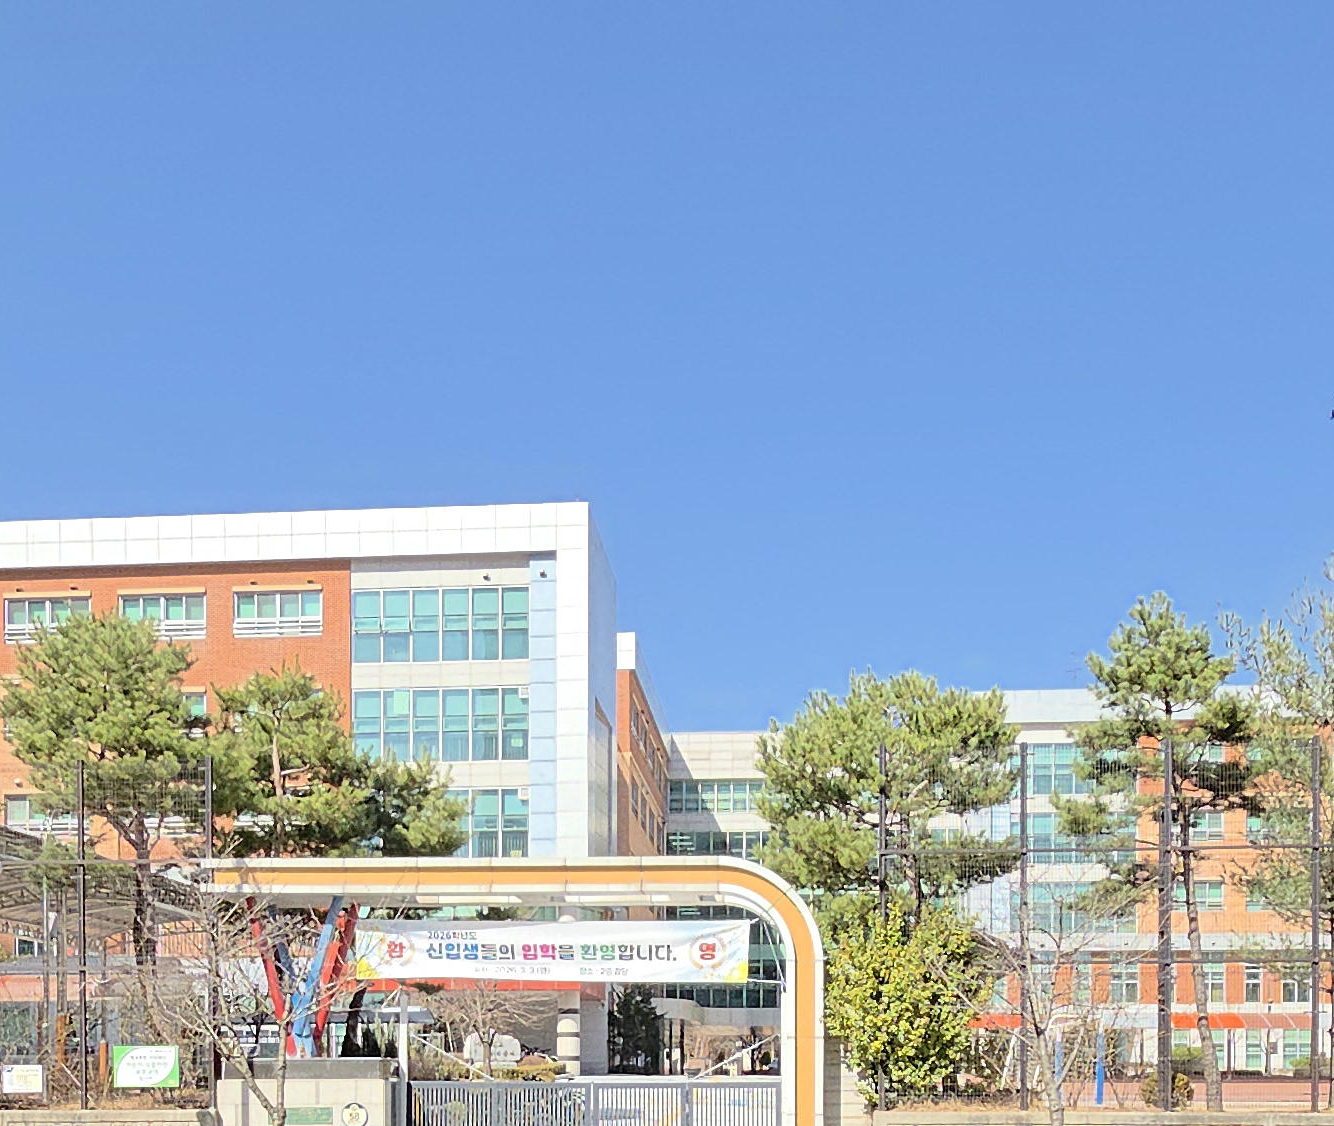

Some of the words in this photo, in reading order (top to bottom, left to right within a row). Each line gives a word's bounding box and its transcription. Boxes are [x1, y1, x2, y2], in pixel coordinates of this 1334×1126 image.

[427, 930, 478, 941] 2026학년도
[387, 940, 406, 959] 환
[426, 943, 515, 960] 신입생들의
[521, 944, 575, 960] 입학을
[580, 944, 677, 961] 환영합니다.
[699, 943, 717, 961] 영
